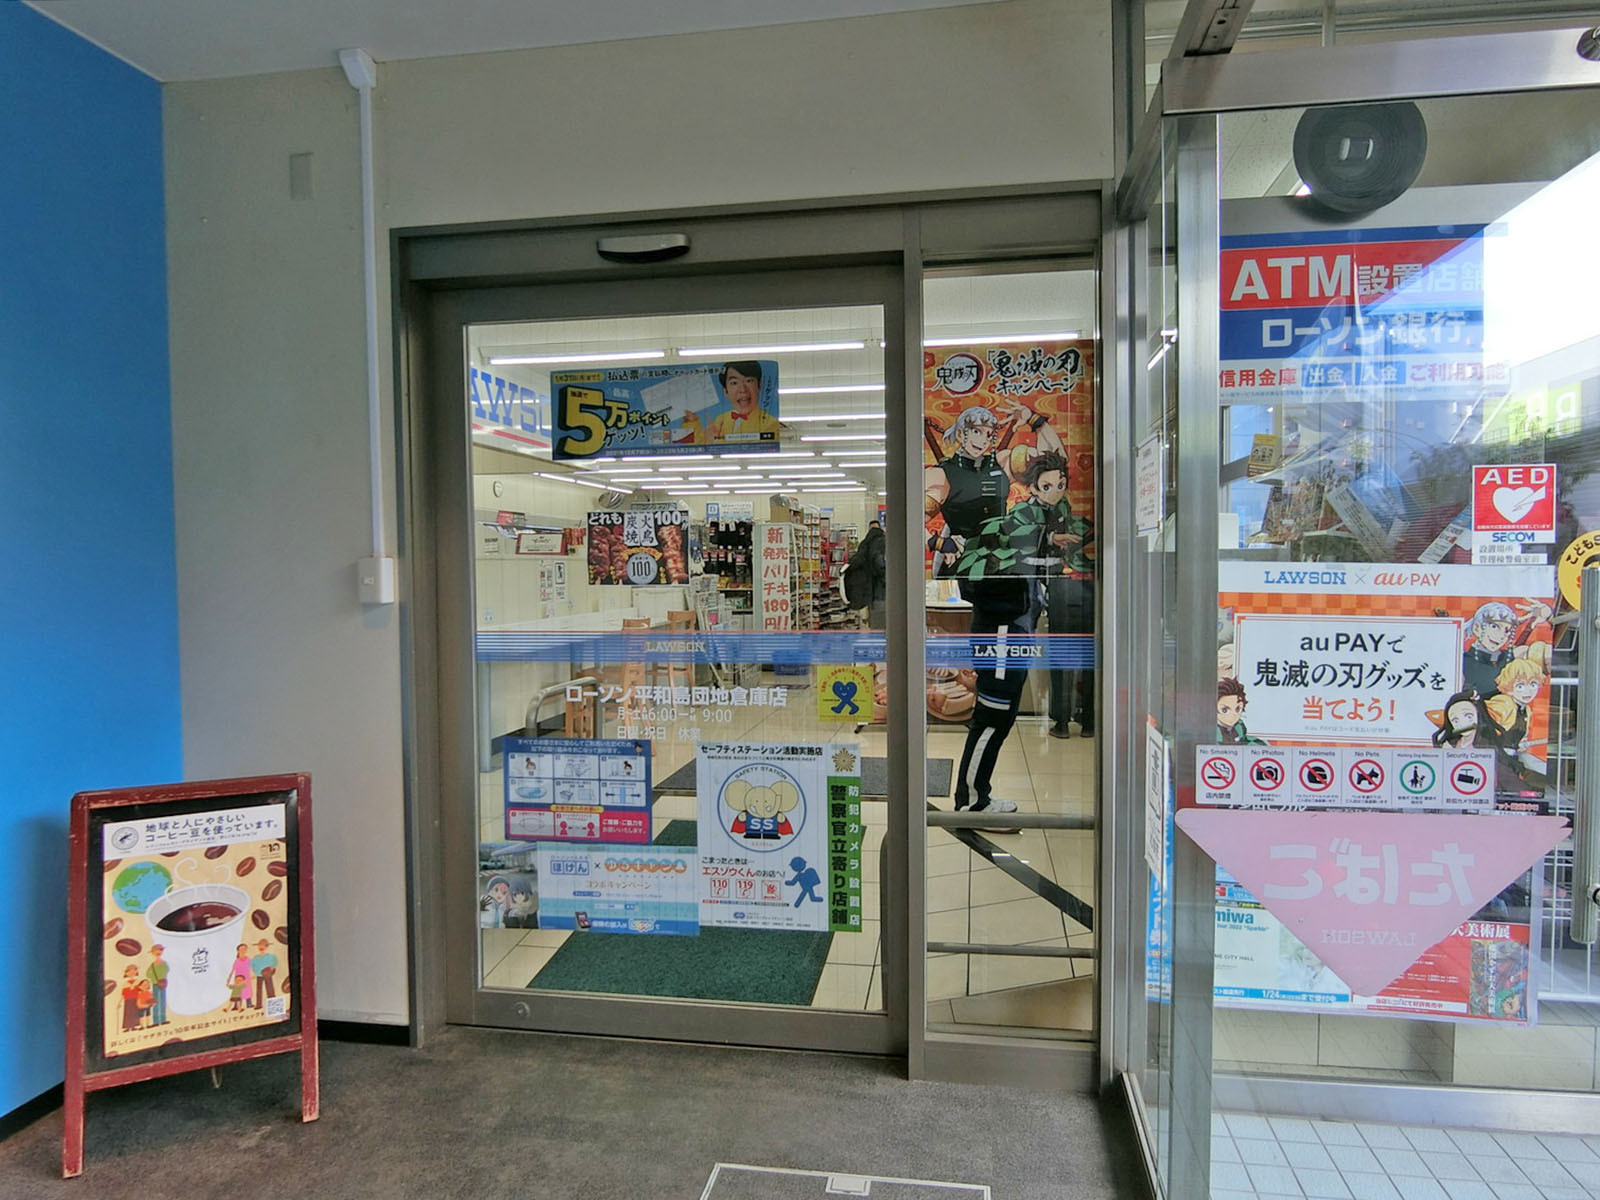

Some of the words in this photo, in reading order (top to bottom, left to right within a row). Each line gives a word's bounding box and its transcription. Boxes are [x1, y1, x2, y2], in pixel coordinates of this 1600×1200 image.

[1230, 255, 1351, 301] ATM
[1262, 312, 1466, 348] ローソン銀行
[1219, 367, 1297, 388] 信用金庫
[1309, 366, 1344, 384] 出金
[1361, 365, 1398, 383] 入金
[996, 377, 1077, 395] キャンペーン
[1481, 468, 1549, 486] AED
[588, 512, 623, 525] どれも
[768, 527, 783, 543] 新
[1492, 531, 1535, 542] SECOM
[763, 547, 788, 560] 発売
[632, 561, 651, 577] 100
[1264, 571, 1346, 586] LAWSON
[1410, 573, 1441, 586] PAY
[764, 581, 789, 595] チキ
[764, 599, 789, 612] 180
[645, 641, 707, 653] LAWSON
[974, 645, 1043, 657] LAWSON
[1254, 659, 1447, 691] 鬼滅の刃グッズを
[566, 684, 788, 707] ローソン平和島団地倉庫店
[703, 709, 732, 722] 9:00
[1302, 696, 1395, 721] 当てよう!
[702, 744, 823, 756] セーフティステーション活動実施店
[1446, 752, 1469, 760] Security
[734, 766, 758, 779] SAFETY
[761, 766, 789, 780] STATION
[146, 814, 245, 832] 地球と人にやさしい
[146, 820, 278, 842] コーヒー豆を使っています。
[831, 785, 847, 925] 警察官立寄り店舗
[552, 861, 588, 874] ほけん
[712, 880, 728, 888] 110
[738, 881, 753, 889] 119
